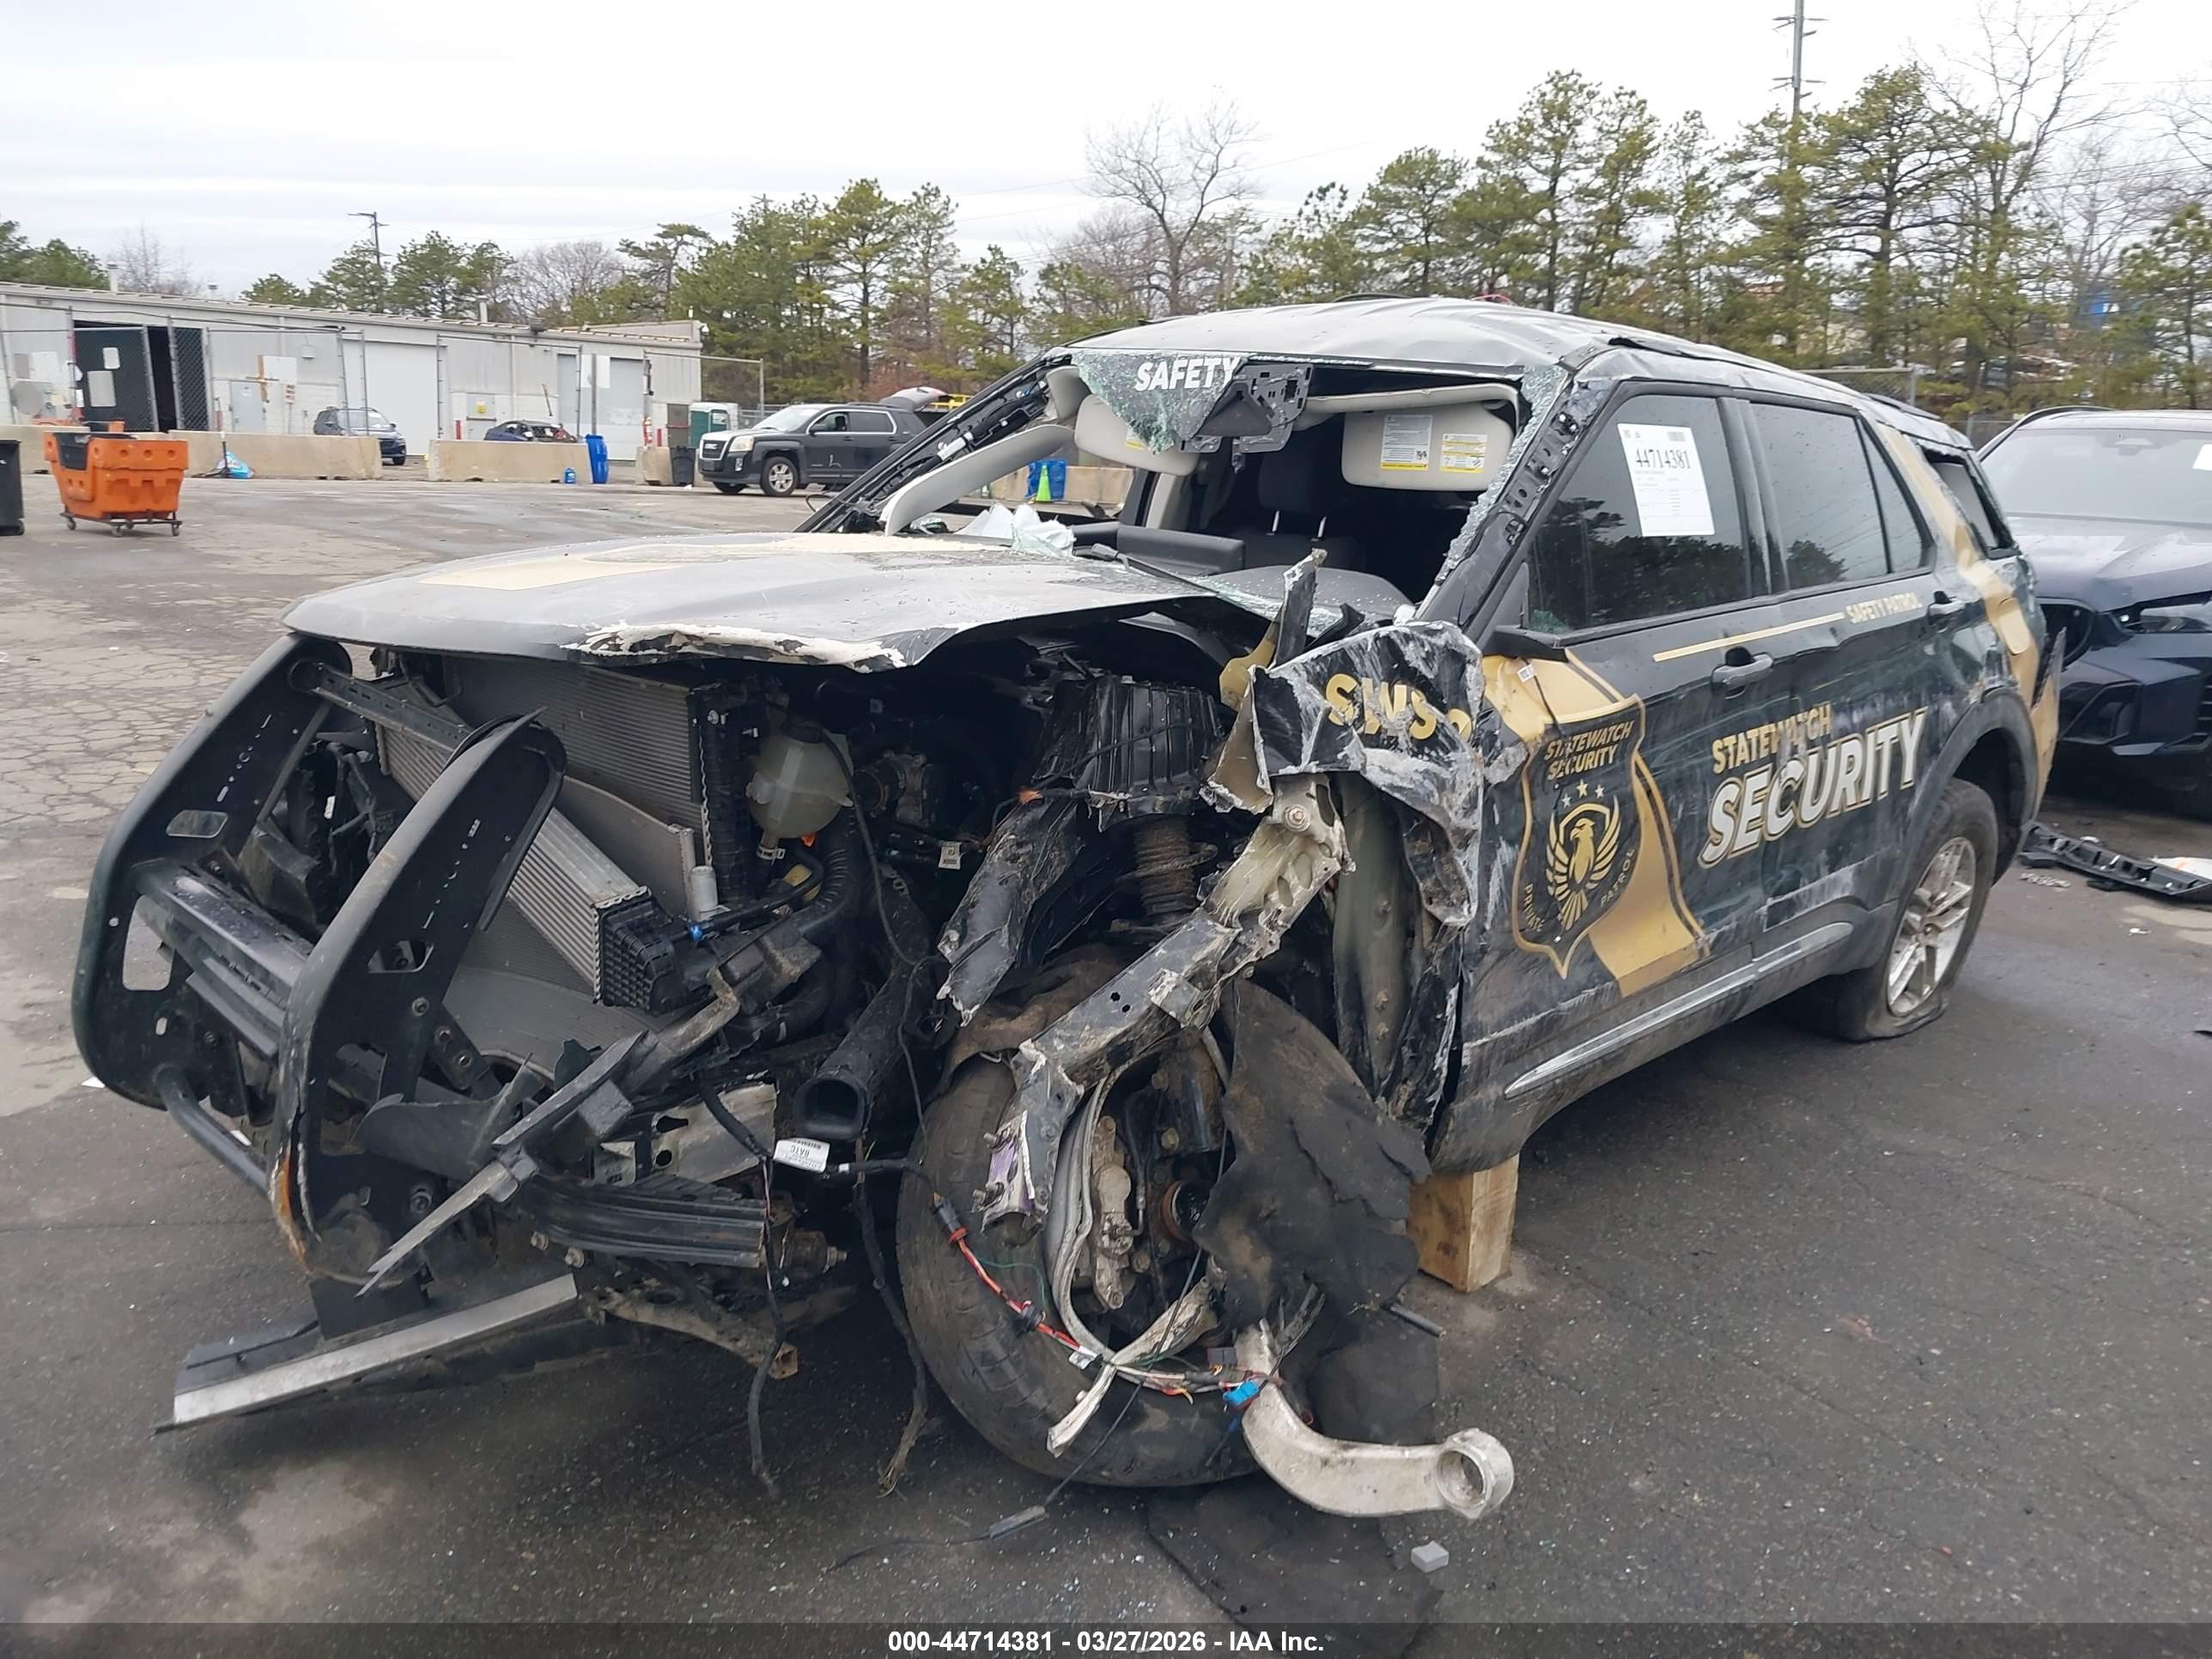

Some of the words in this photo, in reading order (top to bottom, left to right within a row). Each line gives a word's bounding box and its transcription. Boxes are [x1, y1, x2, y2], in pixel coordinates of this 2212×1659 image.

[1134, 356, 1241, 392] SAFETY
[1636, 448, 1691, 469] 44714381
[1846, 599, 1887, 623] SAFETY
[1544, 720, 1635, 761] STATEWATCH
[1547, 744, 1619, 781] SECURITY
[1698, 706, 1929, 869] SECURITY
[1523, 883, 1547, 933] PRIVATE
[1600, 848, 1636, 908] PATROL
